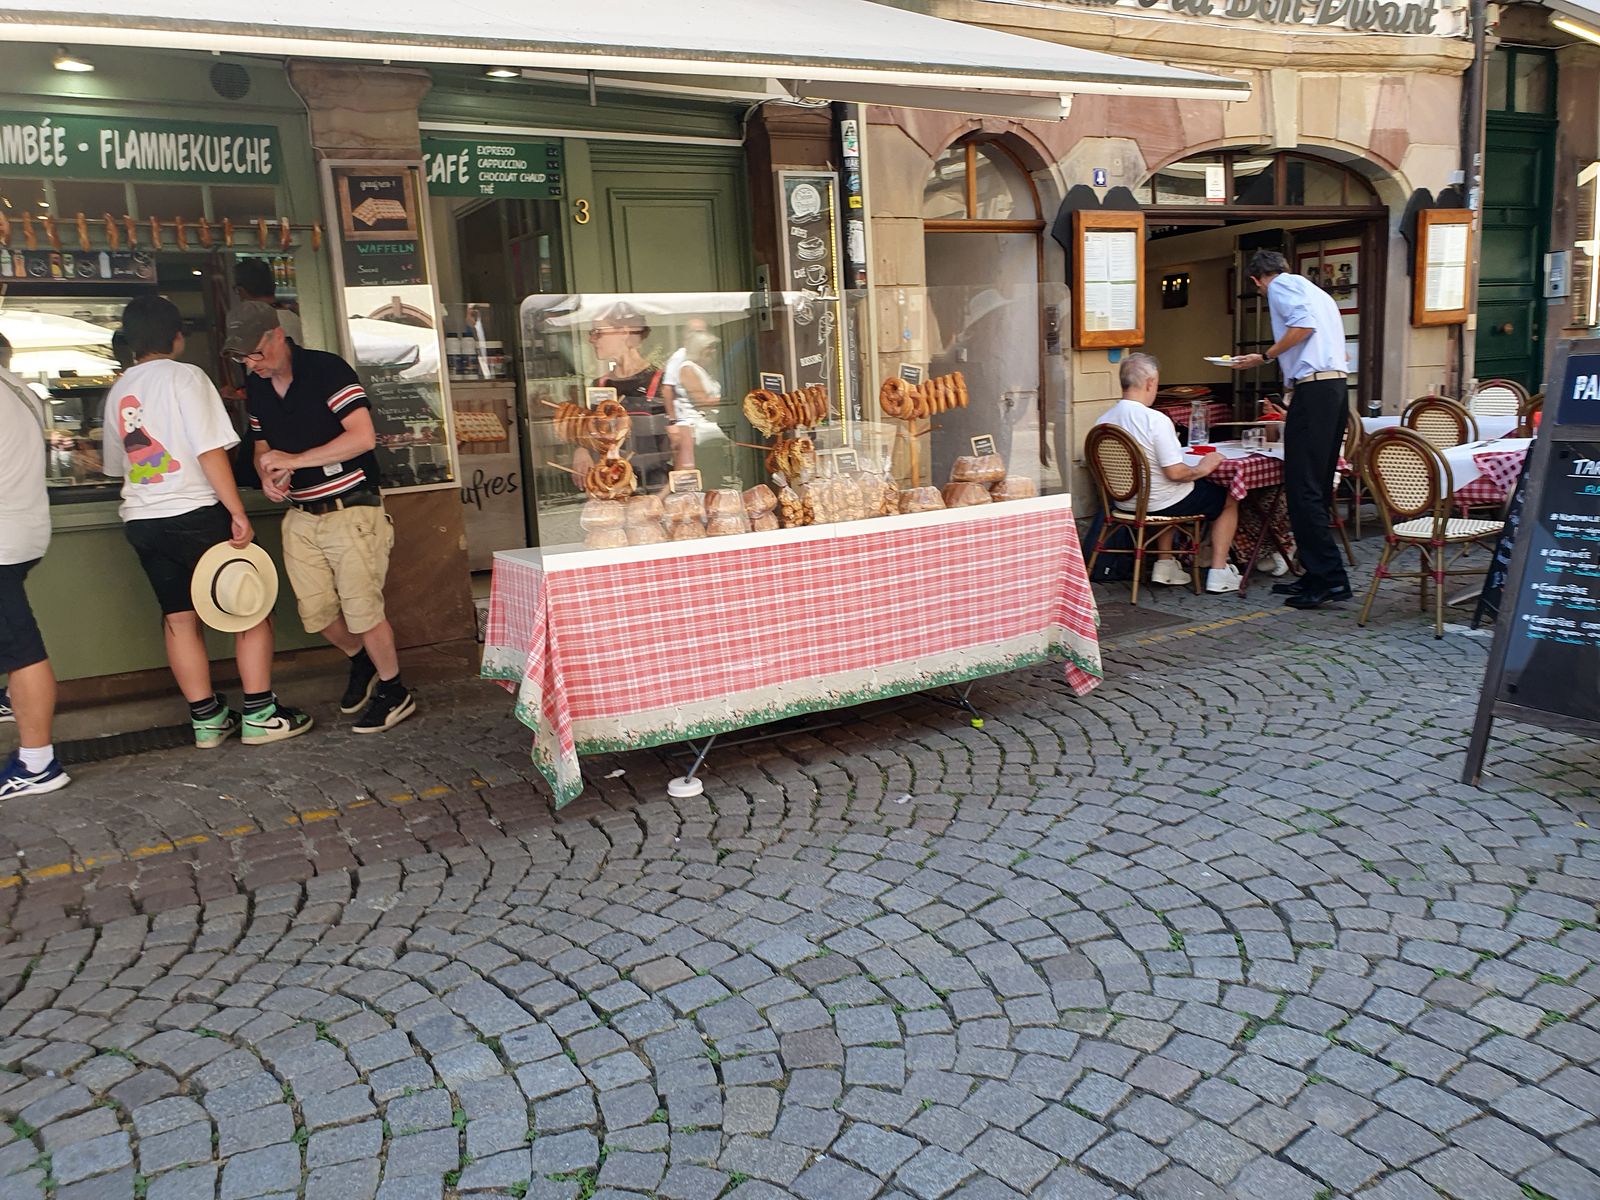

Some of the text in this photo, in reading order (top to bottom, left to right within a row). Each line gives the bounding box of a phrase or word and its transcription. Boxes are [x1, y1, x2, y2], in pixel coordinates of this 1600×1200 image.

[100, 129, 272, 175] FLAMMEKUECHE
[476, 145, 516, 156] EXPRESSO
[477, 158, 527, 169] CAPPUCCINO
[478, 171, 518, 182] CHOCOLAT
[479, 183, 495, 194] THÉ
[575, 199, 590, 224] 3
[356, 243, 415, 254] WAFFELN
[1572, 374, 1600, 400] PA
